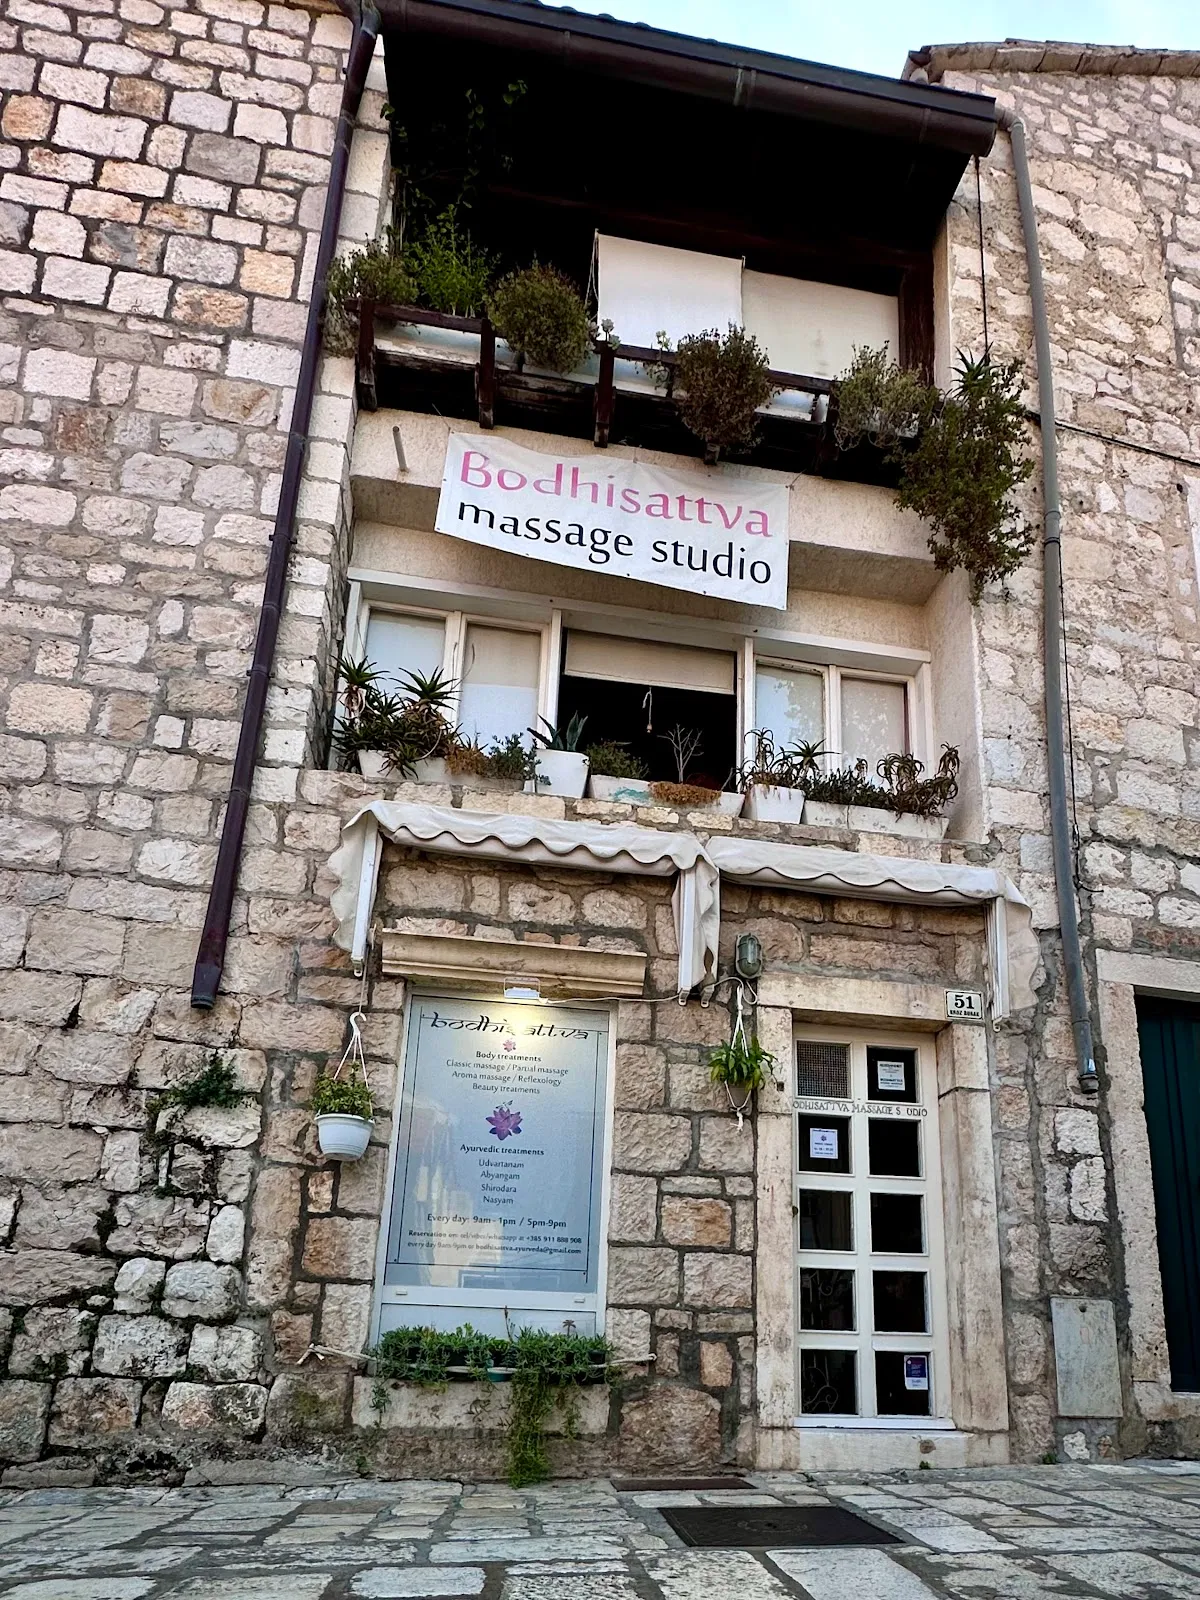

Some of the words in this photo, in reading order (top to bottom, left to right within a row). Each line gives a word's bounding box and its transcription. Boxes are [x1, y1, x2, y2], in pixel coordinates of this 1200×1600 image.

[460, 451, 772, 537] Bodhisattva
[458, 501, 634, 564] massage
[651, 540, 772, 585] studio
[954, 994, 974, 1009] 51
[476, 1051, 495, 1061] Body
[498, 1053, 542, 1062] treatments
[446, 1059, 471, 1068] Classic
[473, 1063, 505, 1073] massage
[512, 1064, 536, 1073] Partial
[537, 1067, 569, 1077] massage
[452, 1071, 478, 1080] Aroma
[479, 1074, 511, 1083] massage
[518, 1075, 562, 1087] Reflexology
[472, 1083, 498, 1093] Beauty
[500, 1085, 540, 1094] treatments
[460, 1144, 500, 1154] Ayurvedic
[501, 1147, 545, 1156] treatments
[481, 1183, 517, 1193] Shirodara
[483, 1195, 514, 1206] Nasyam
[427, 1213, 450, 1225] Every
[472, 1215, 491, 1224] 9am
[499, 1217, 516, 1227] 1pm
[527, 1218, 567, 1229] 5pm-9pm
